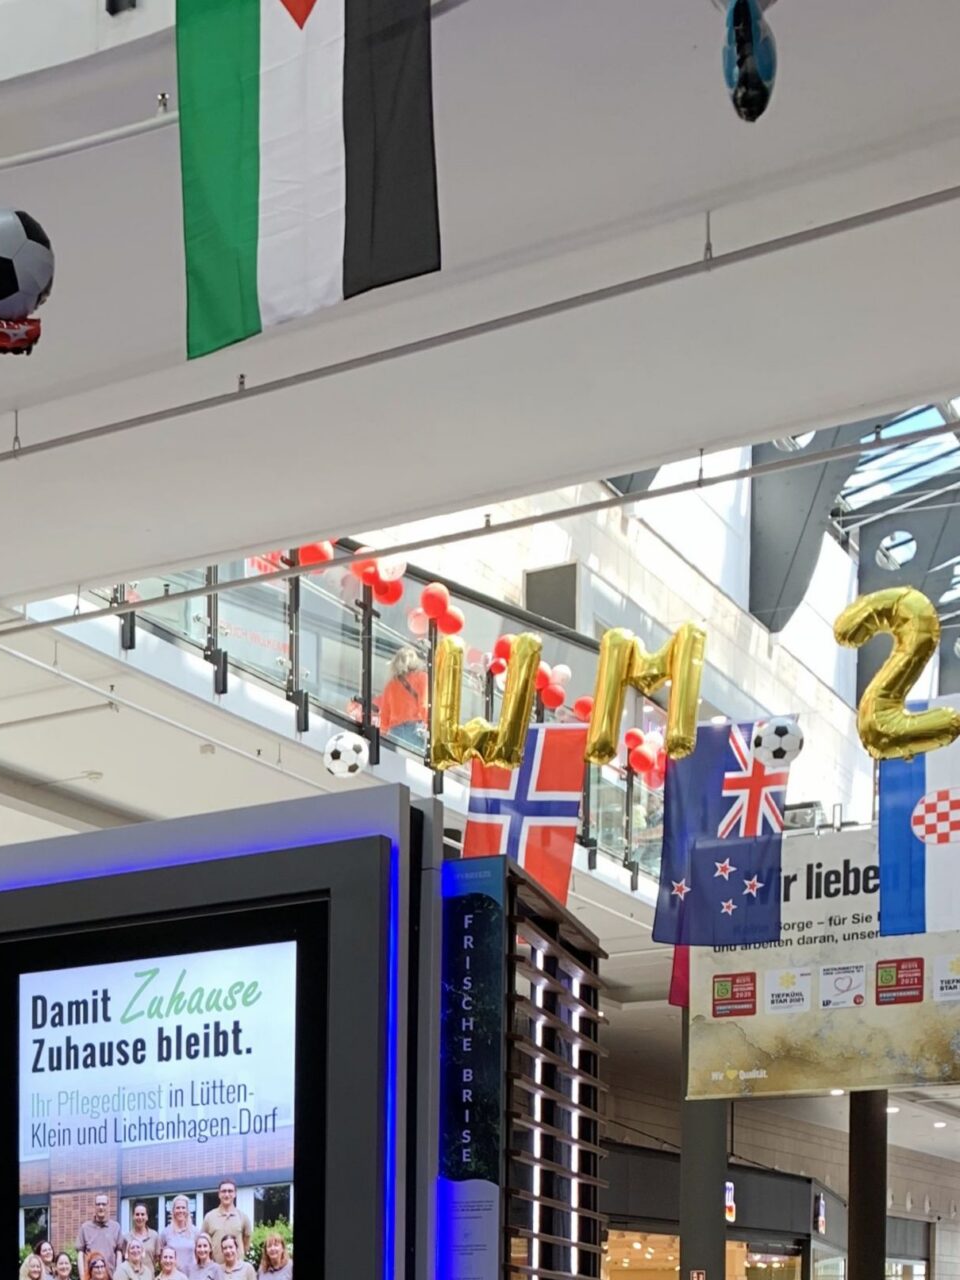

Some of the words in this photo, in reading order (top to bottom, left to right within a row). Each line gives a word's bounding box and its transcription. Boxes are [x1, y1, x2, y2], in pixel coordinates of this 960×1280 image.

[833, 585, 960, 761] 2
[797, 933, 838, 947] daran,
[827, 915, 848, 928] für
[851, 913, 872, 926] Sie
[32, 989, 112, 1029] Damit
[120, 968, 262, 1025] Zuhause
[462, 914, 474, 1051] FRISCHE
[32, 1036, 146, 1073] Zuhause
[157, 1020, 253, 1062] bleibt.
[31, 1093, 53, 1118] Ihr
[57, 1085, 163, 1119] Pflegedienst
[169, 1083, 184, 1108] in
[191, 1080, 255, 1107] Lütten-
[462, 1069, 473, 1162] BRISE
[32, 1123, 72, 1148] Klein
[77, 1119, 107, 1145] und
[114, 1107, 278, 1144] Lichtenhagen-Dorf
